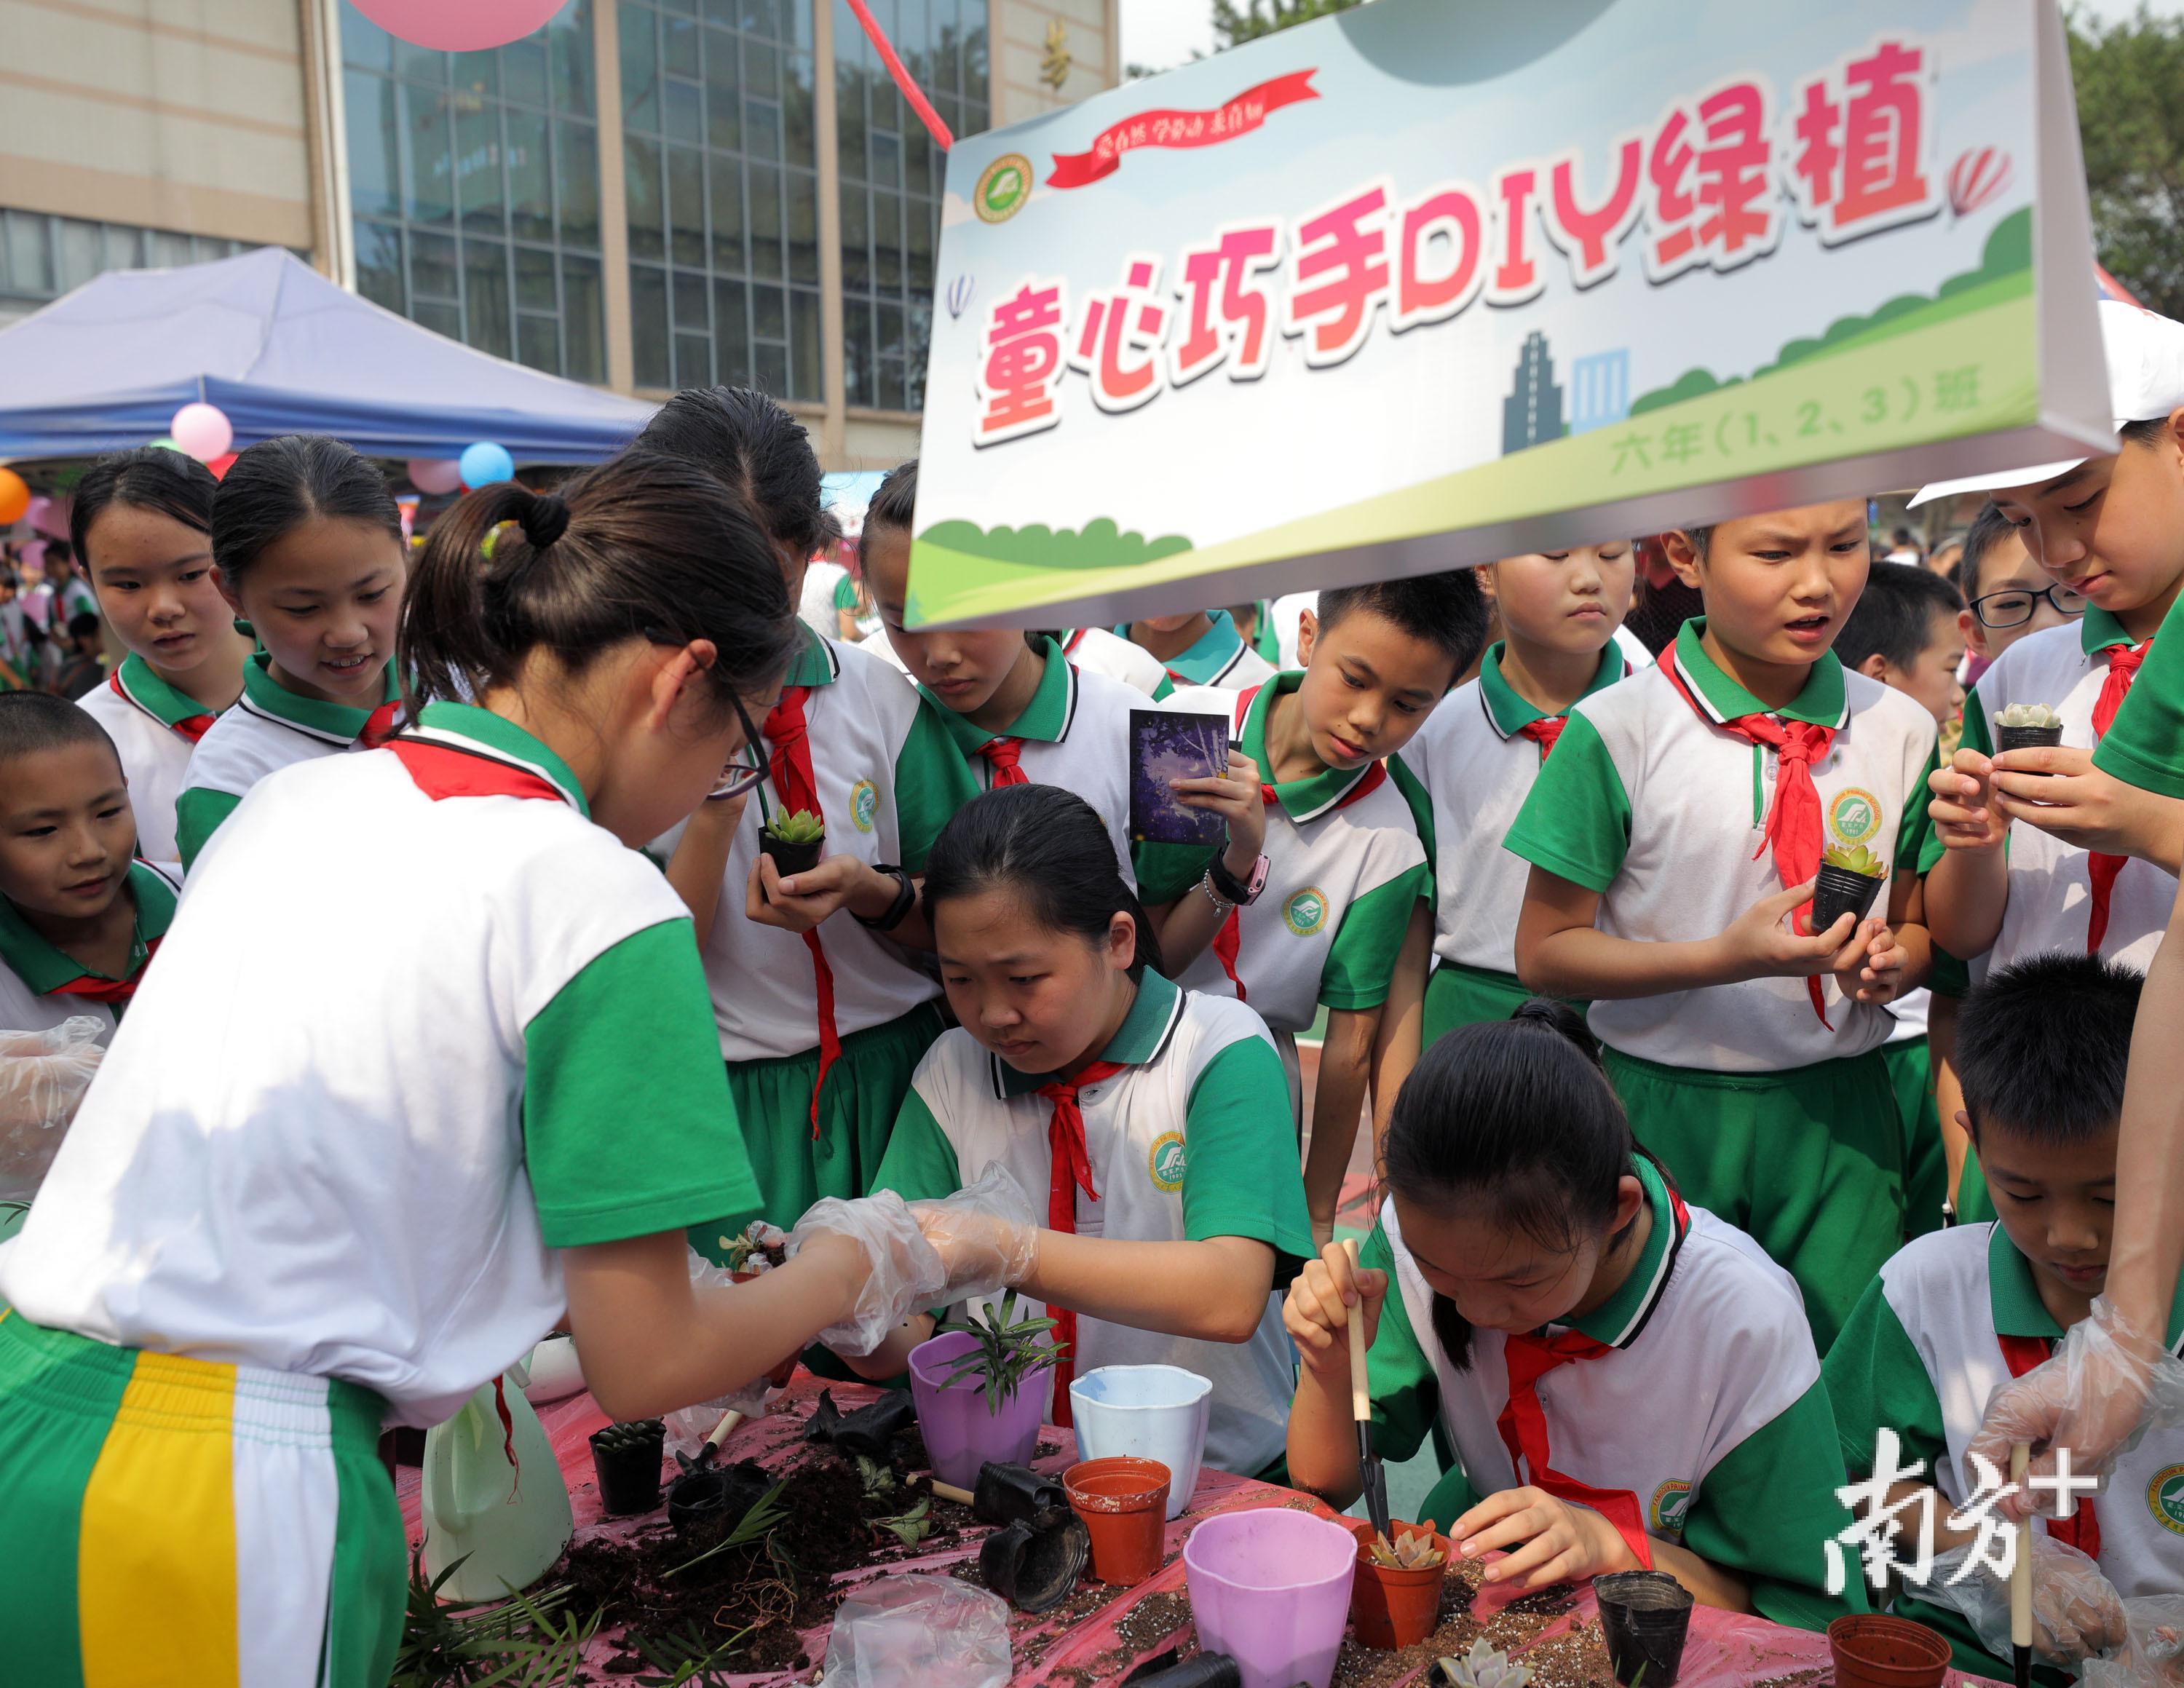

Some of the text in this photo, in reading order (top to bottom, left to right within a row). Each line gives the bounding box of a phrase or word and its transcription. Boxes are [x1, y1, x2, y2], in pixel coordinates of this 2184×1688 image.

[979, 39, 1932, 440] 童心巧手DIY绿植
